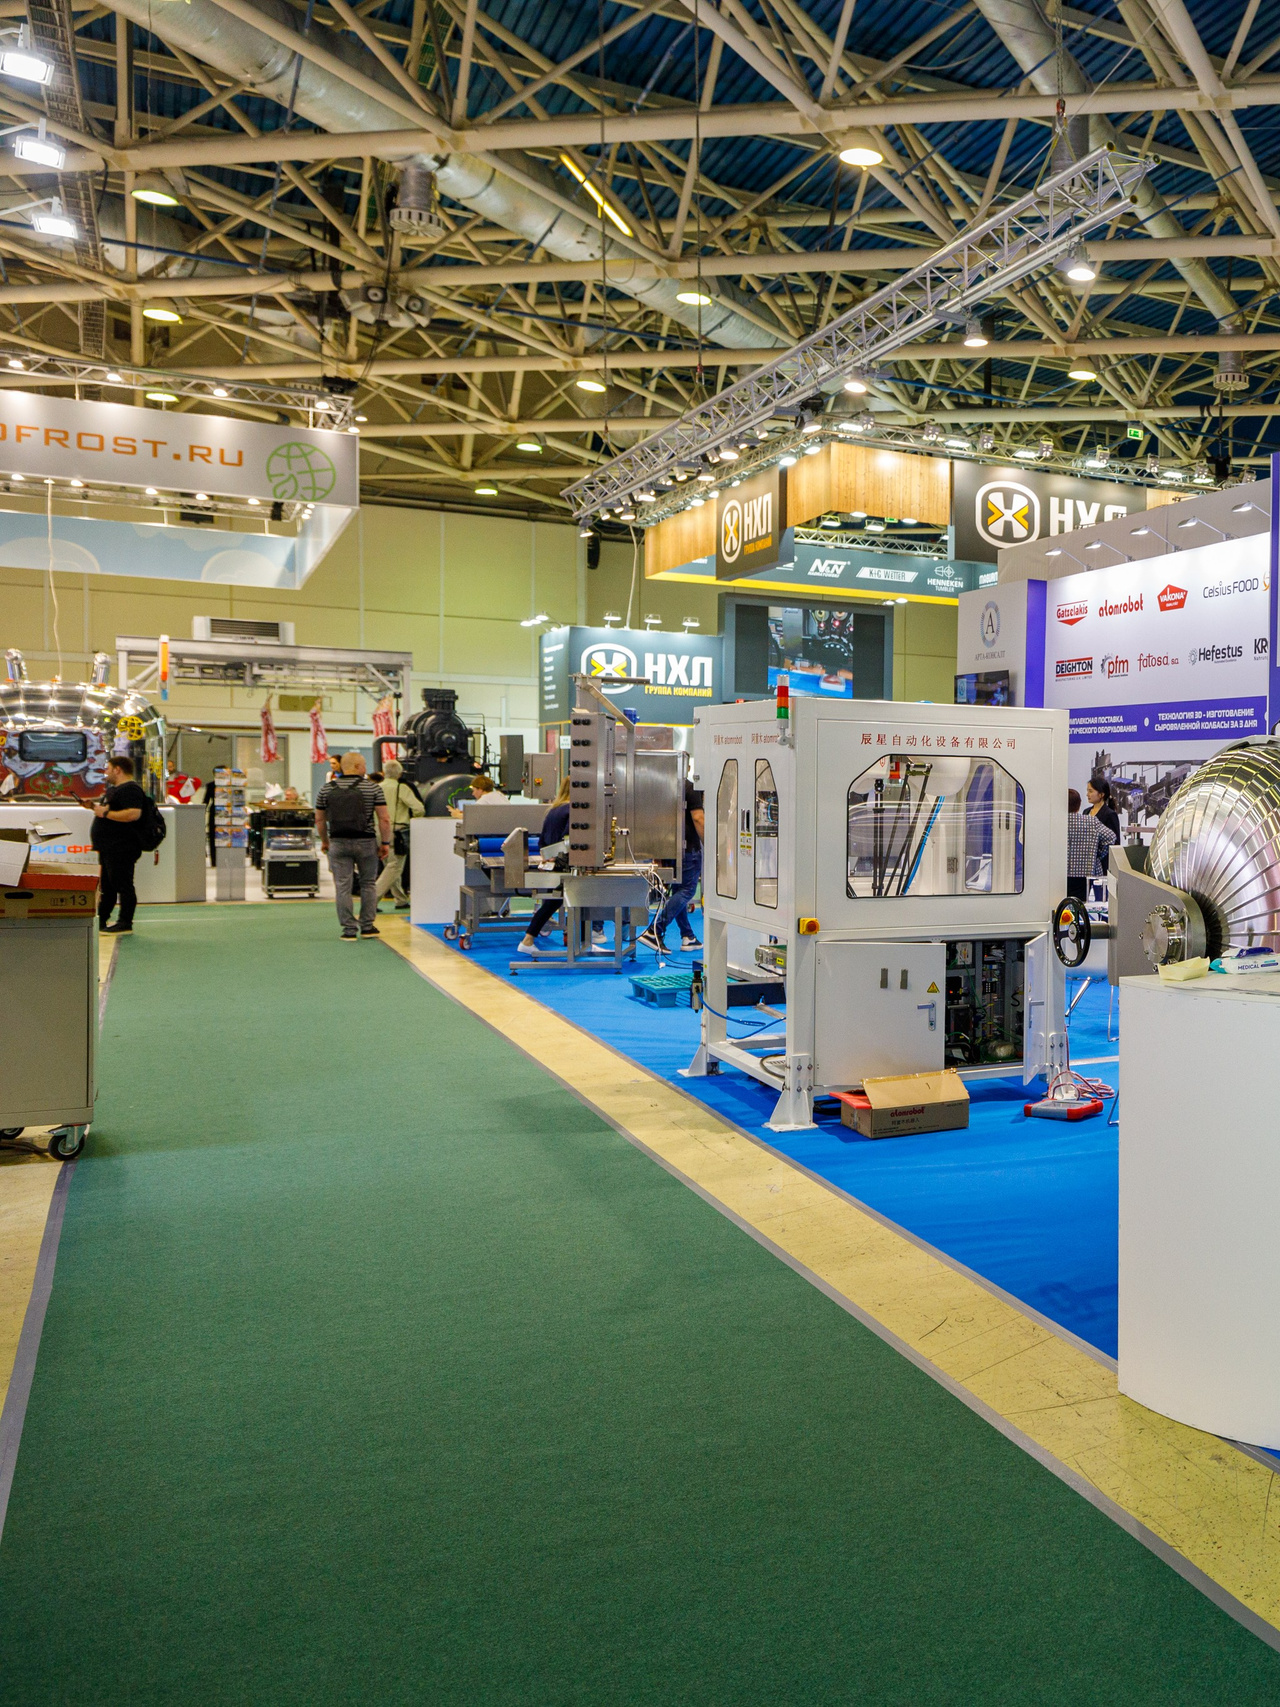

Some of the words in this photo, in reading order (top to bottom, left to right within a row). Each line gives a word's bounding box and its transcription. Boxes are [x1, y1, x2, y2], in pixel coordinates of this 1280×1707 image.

[0, 423, 243, 467] FROST.RU
[744, 492, 772, 541] НХЛ
[927, 577, 964, 588] HENNEKEN
[1203, 580, 1232, 599] Celsius
[1232, 578, 1259, 593] FOOD
[1056, 604, 1088, 619] Gatzelakis
[1198, 645, 1243, 661] Hefestus
[1254, 637, 1269, 654] KR
[645, 653, 713, 687] НХЛ
[1055, 660, 1093, 675] DEIGHTON
[1108, 655, 1129, 679] pfm
[645, 685, 672, 696] ГРУППА
[673, 686, 713, 698] КОМПАНИЙ
[1098, 715, 1124, 724] ПОСТАВКА
[1158, 711, 1194, 721] ТЕХНОЛОГИЯ
[1206, 708, 1254, 718] ИЗГОТОВЛЕНИЕ
[1098, 725, 1138, 734] ОБОРУДОВАНИЯ
[1154, 721, 1200, 731] СЫРОВЯЛЕННОЙ
[1201, 720, 1230, 729] КОЛБАСЫ
[1244, 719, 1258, 728] ДНЯ
[860, 733, 1017, 749] 辰星自动化设备有限公司
[70, 895, 87, 906] 13
[890, 1106, 925, 1118] atomrobot
